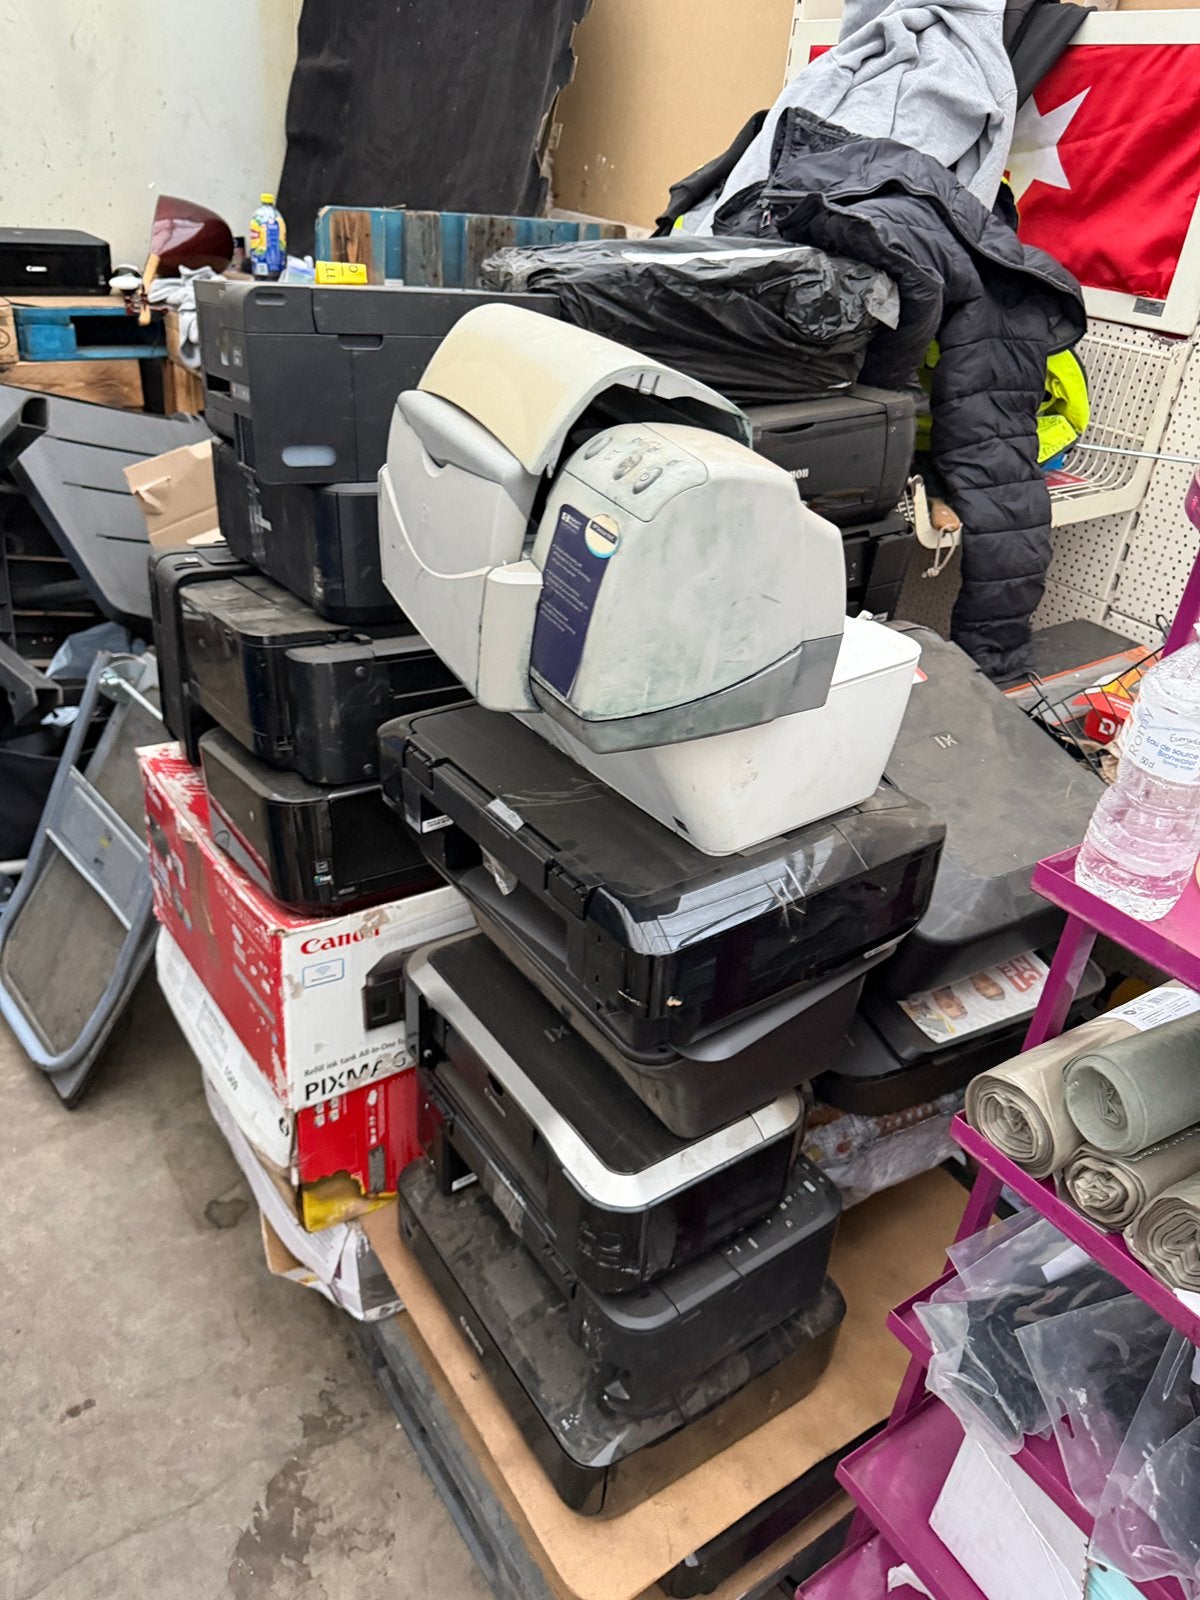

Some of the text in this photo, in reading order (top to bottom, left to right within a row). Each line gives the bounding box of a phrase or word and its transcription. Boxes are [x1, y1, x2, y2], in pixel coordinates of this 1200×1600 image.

[789, 468, 810, 480] non
[1146, 735, 1199, 760] Eau de source
[326, 1059, 338, 1070] ink
[340, 1054, 357, 1065] tank
